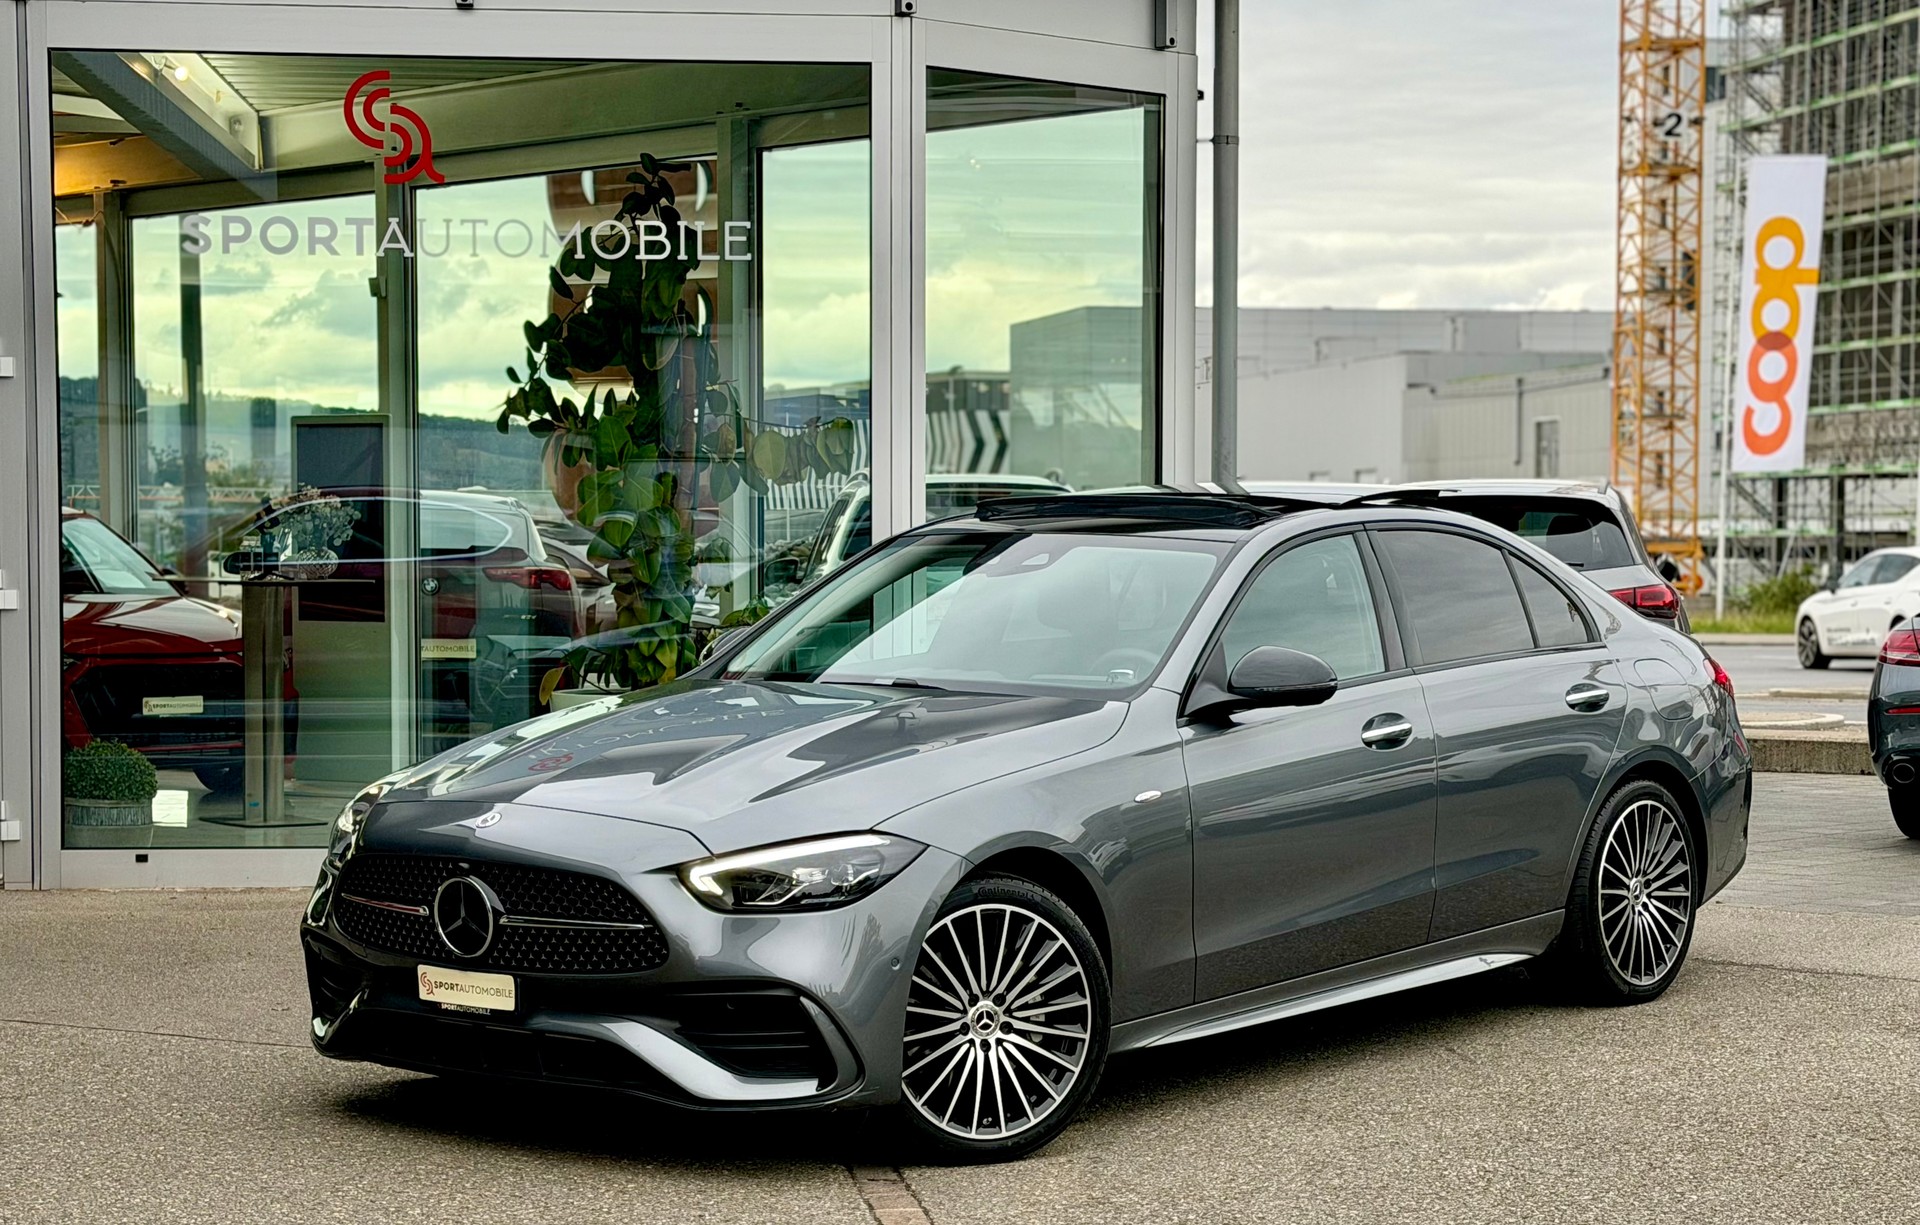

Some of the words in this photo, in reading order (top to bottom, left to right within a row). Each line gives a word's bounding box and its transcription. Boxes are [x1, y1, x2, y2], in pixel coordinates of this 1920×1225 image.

[1665, 113, 1682, 136] 2
[182, 214, 752, 261] SPORTAUTOMOBILE
[1743, 216, 1820, 456] coop
[434, 980, 513, 999] SPORTAUTOMOBILE
